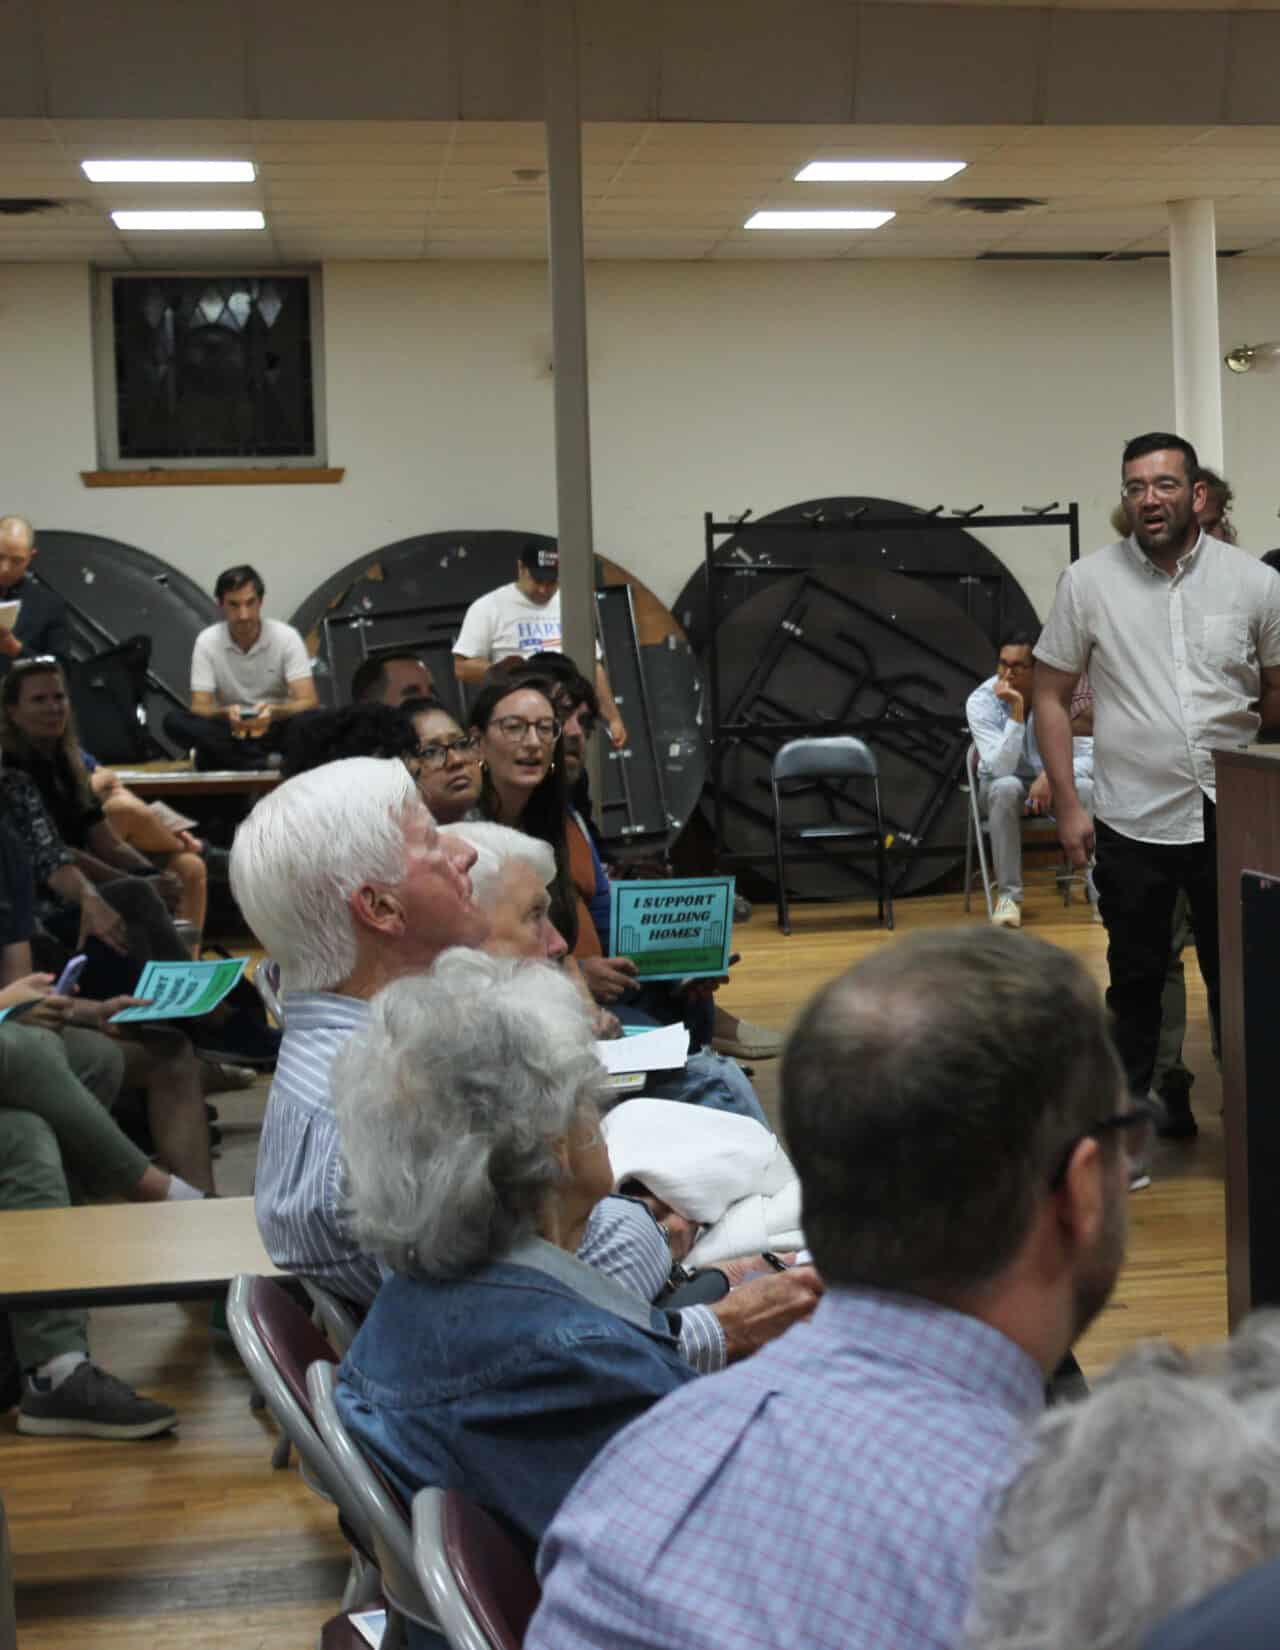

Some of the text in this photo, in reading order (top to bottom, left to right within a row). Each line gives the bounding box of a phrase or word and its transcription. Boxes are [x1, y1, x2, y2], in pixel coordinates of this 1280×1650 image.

[633, 894, 716, 908] I SUPPORT
[641, 911, 711, 925] BUILDING
[649, 927, 702, 941] HOMES
